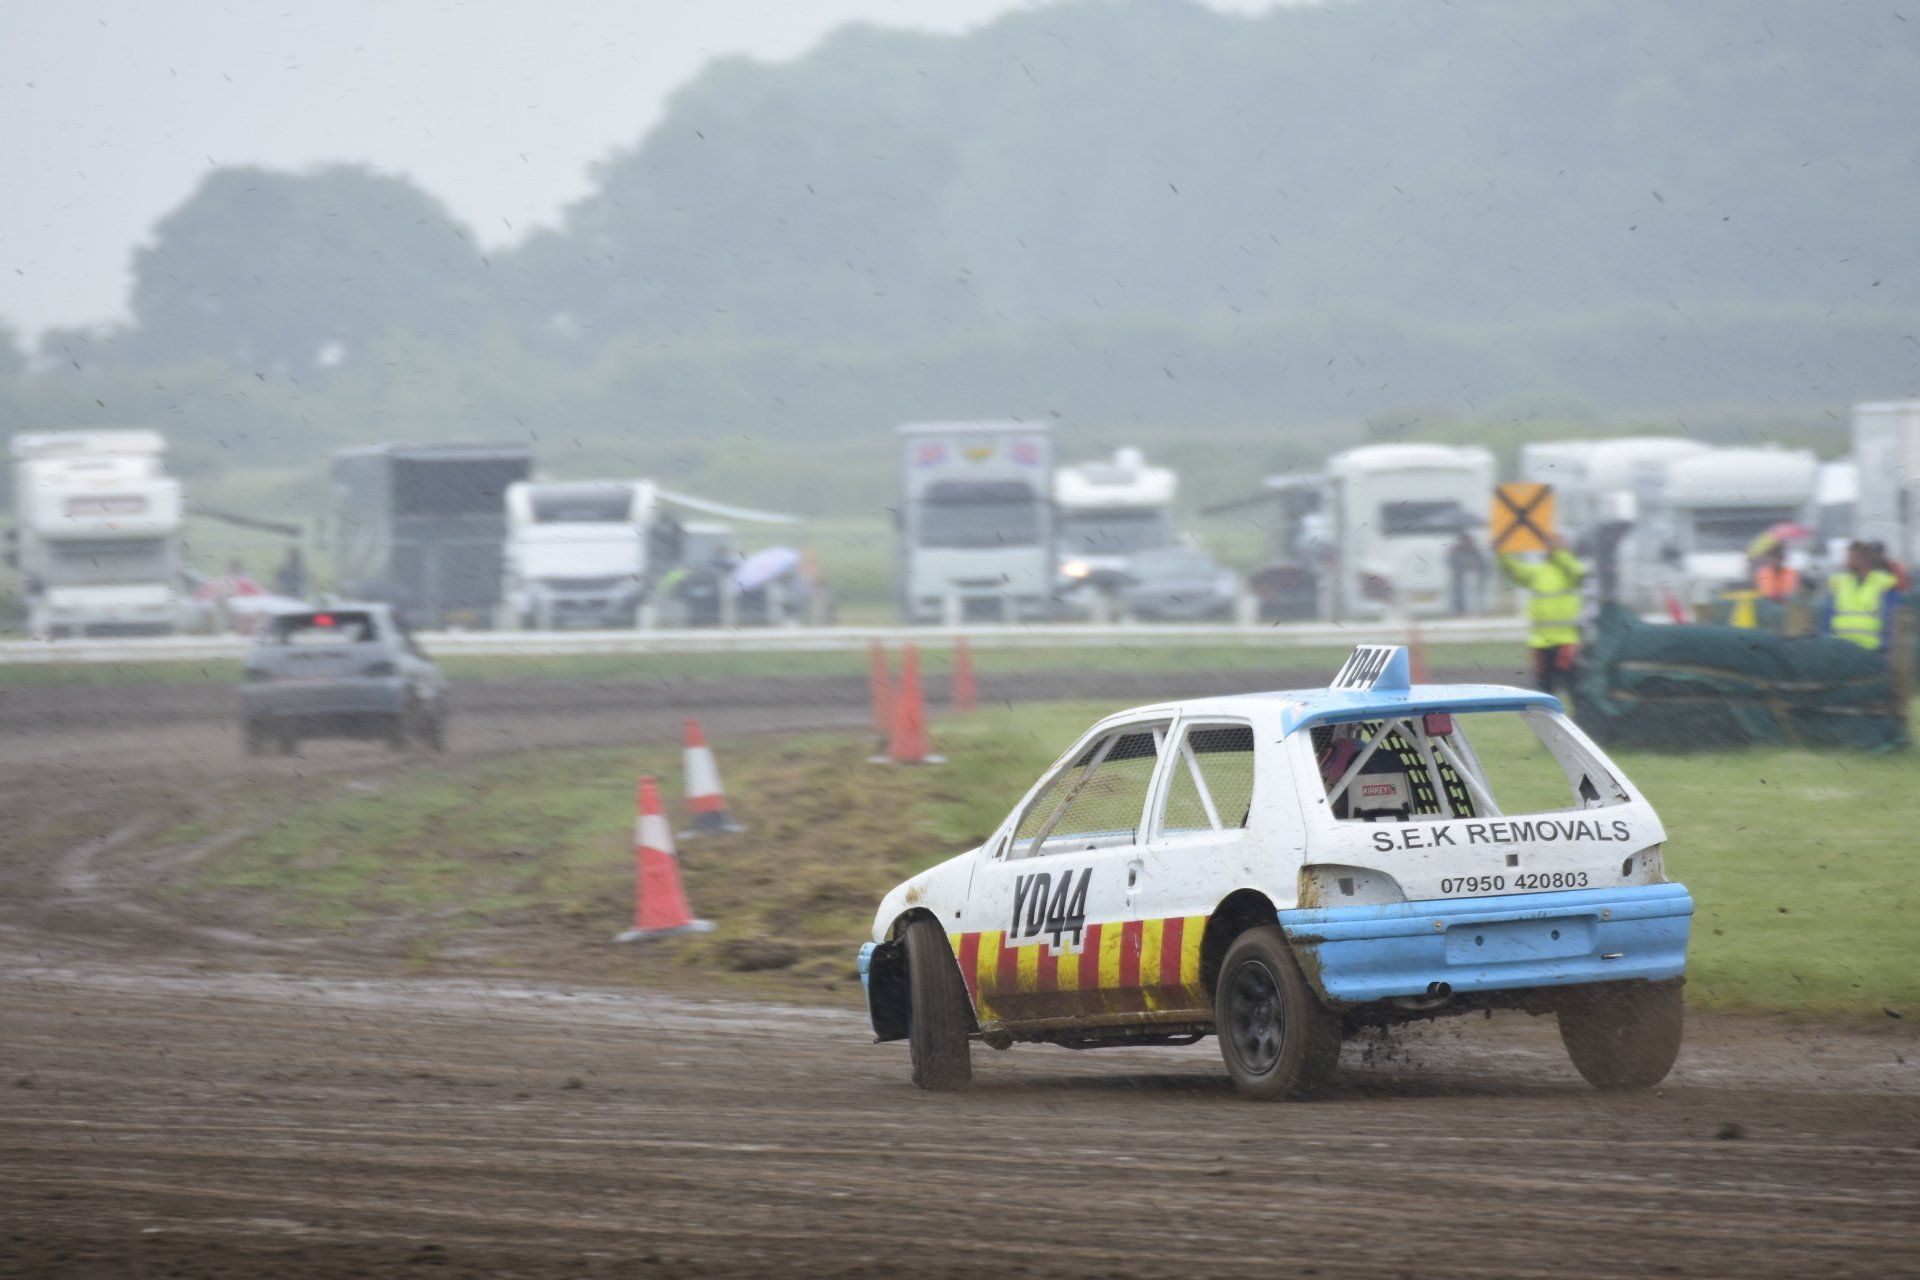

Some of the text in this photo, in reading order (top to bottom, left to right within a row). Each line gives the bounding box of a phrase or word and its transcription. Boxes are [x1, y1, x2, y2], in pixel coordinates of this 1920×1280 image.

[1336, 648, 1392, 690] YD44
[1372, 820, 1630, 851] S.E.K REMOVALS
[1441, 872, 1588, 893] 07950 420803
[1010, 867, 1093, 948] YD44
